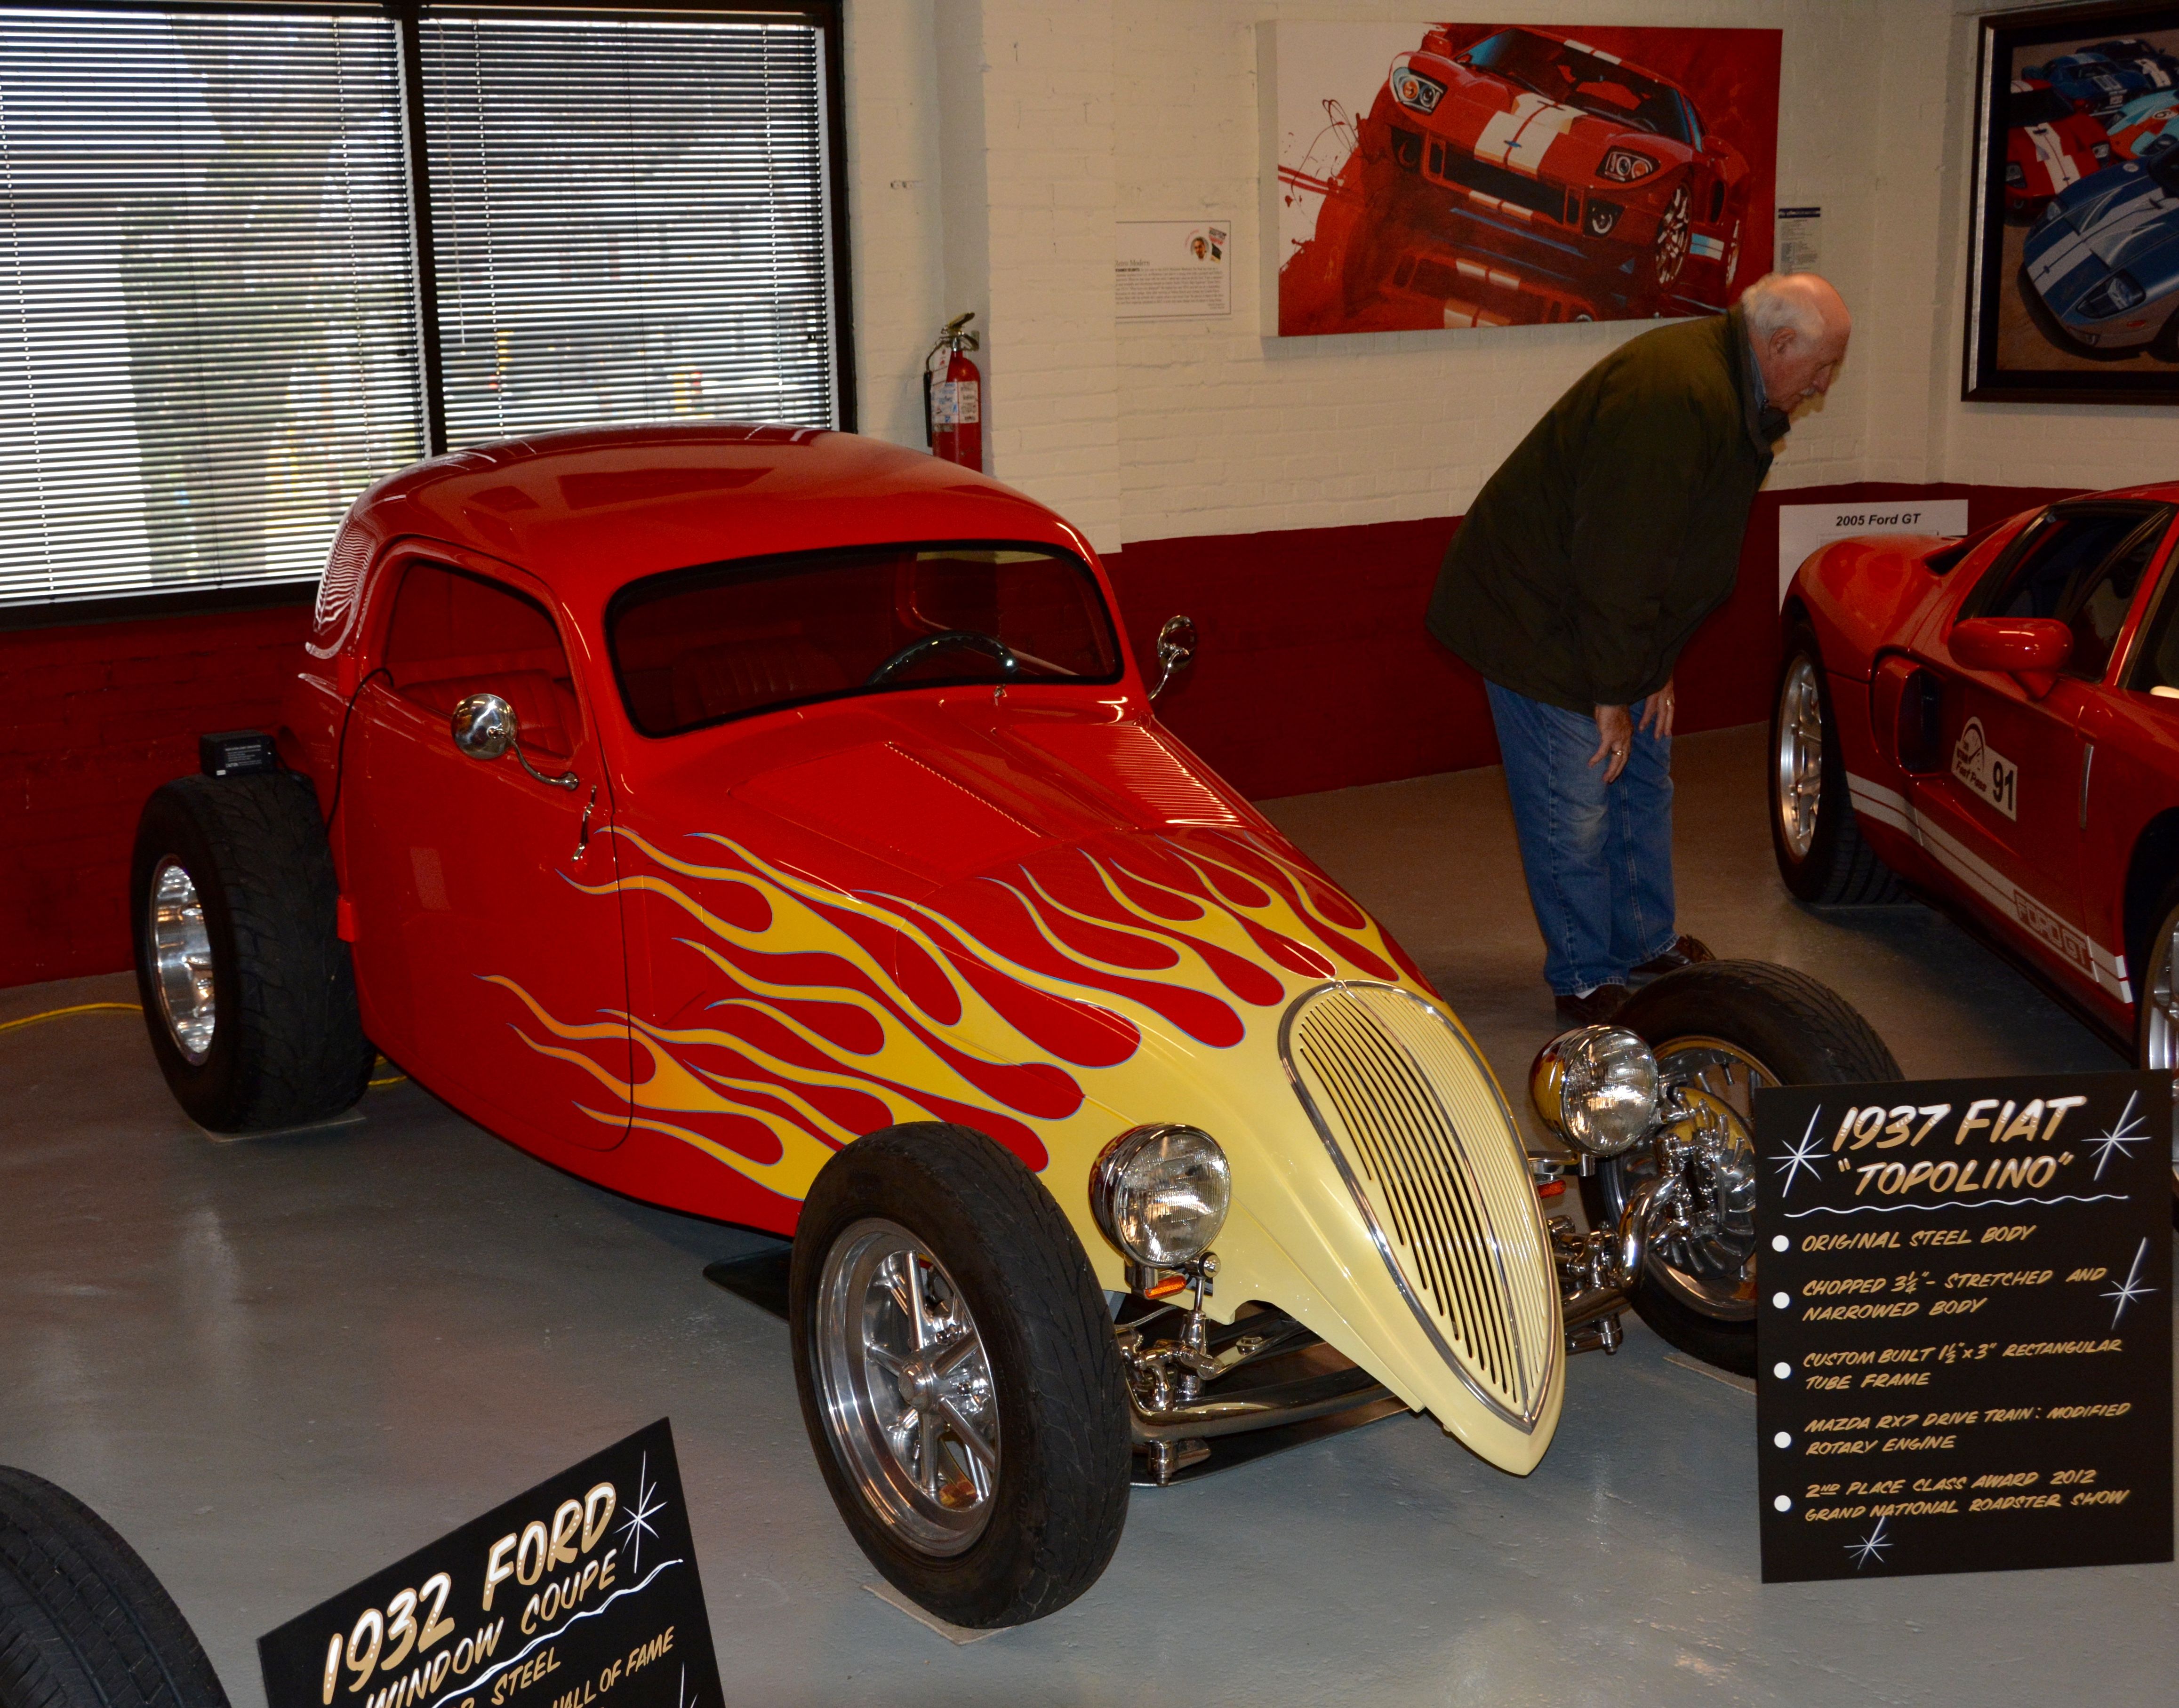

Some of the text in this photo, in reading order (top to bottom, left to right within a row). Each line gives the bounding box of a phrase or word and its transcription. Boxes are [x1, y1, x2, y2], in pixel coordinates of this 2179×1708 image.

[1836, 513, 1921, 526] 2005 Ford GT
[1993, 761, 2014, 811] 91
[2016, 894, 2087, 965] FORD GT
[1833, 1096, 2087, 1152] 1937 FIAT
[1802, 1225, 2036, 1252] ORIGINAL STEEL BODY
[1802, 1278, 1886, 1296] CHOPPED
[1945, 1270, 2053, 1288] STRETCHED
[2066, 1268, 2107, 1282] AND
[1802, 1298, 1987, 1321] NARROWED BODY
[1803, 1351, 1875, 1367] CUSTOM
[1878, 1347, 1936, 1363] BUILT
[2003, 1339, 2122, 1357] RECTANGULAR
[1806, 1373, 1931, 1389] TUBE FRAME
[1804, 1417, 1871, 1432] MAZDA
[1875, 1414, 1919, 1428] RX7
[1923, 1411, 1979, 1426] DRIVE
[2047, 1403, 2131, 1419] MODIFIED
[1806, 1435, 1956, 1455] ROTARY ENGINE
[1846, 1479, 1906, 1495] PLACE
[1913, 1477, 1967, 1491] CLASS
[1971, 1472, 2039, 1488] AWARD
[2050, 1469, 2097, 1485] 2012
[1805, 1490, 2130, 1521] GRAND NATIONAL ROADSTER SHOW
[323, 1482, 617, 1704] 1932 FORD
[366, 1548, 617, 1708] WINDOW COUPE
[600, 1659, 622, 1692] OF
[626, 1626, 674, 1676] FAME
[491, 1647, 561, 1705] STEEL
